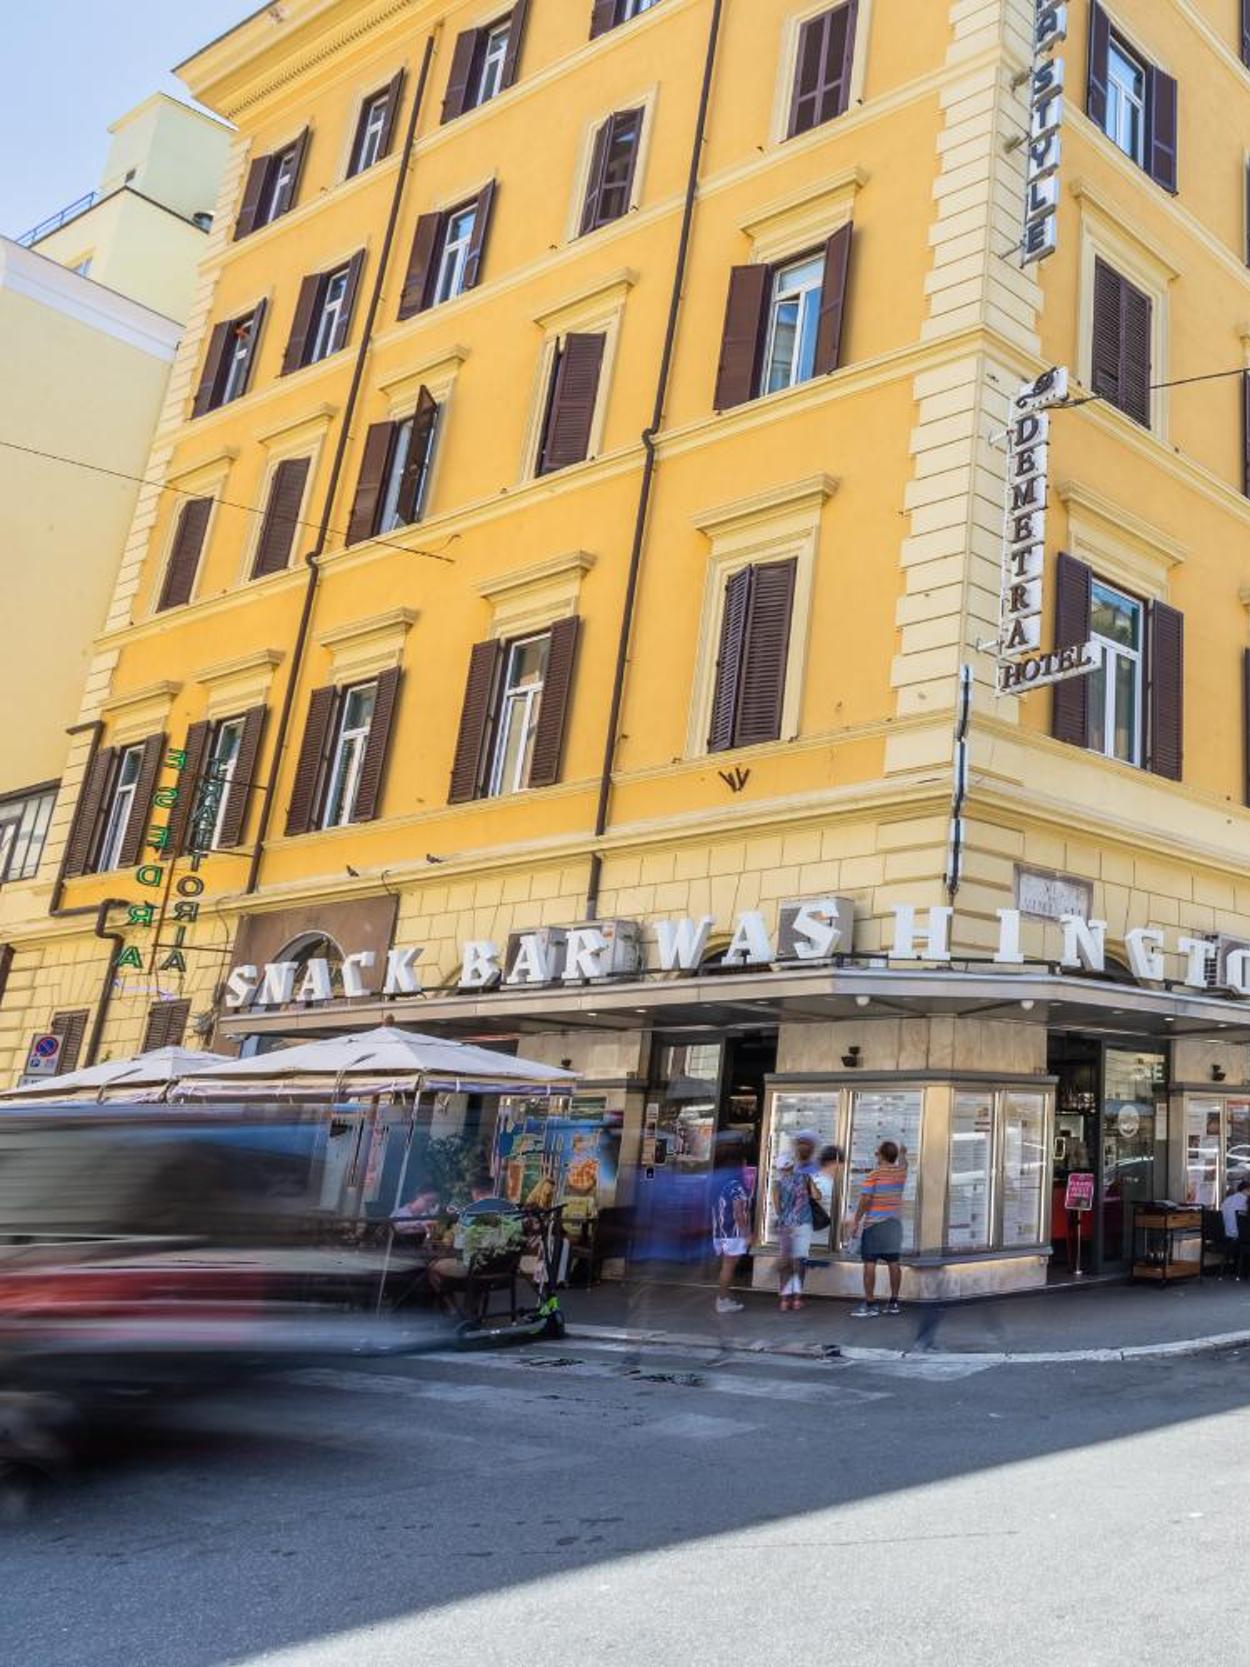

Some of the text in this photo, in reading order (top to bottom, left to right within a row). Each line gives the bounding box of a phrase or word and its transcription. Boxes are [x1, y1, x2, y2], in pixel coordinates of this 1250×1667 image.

[1007, 416, 1038, 648] DEMETRA
[1002, 643, 1093, 690] HOTEL
[226, 947, 424, 1008] SNACK
[458, 928, 608, 987] BAR
